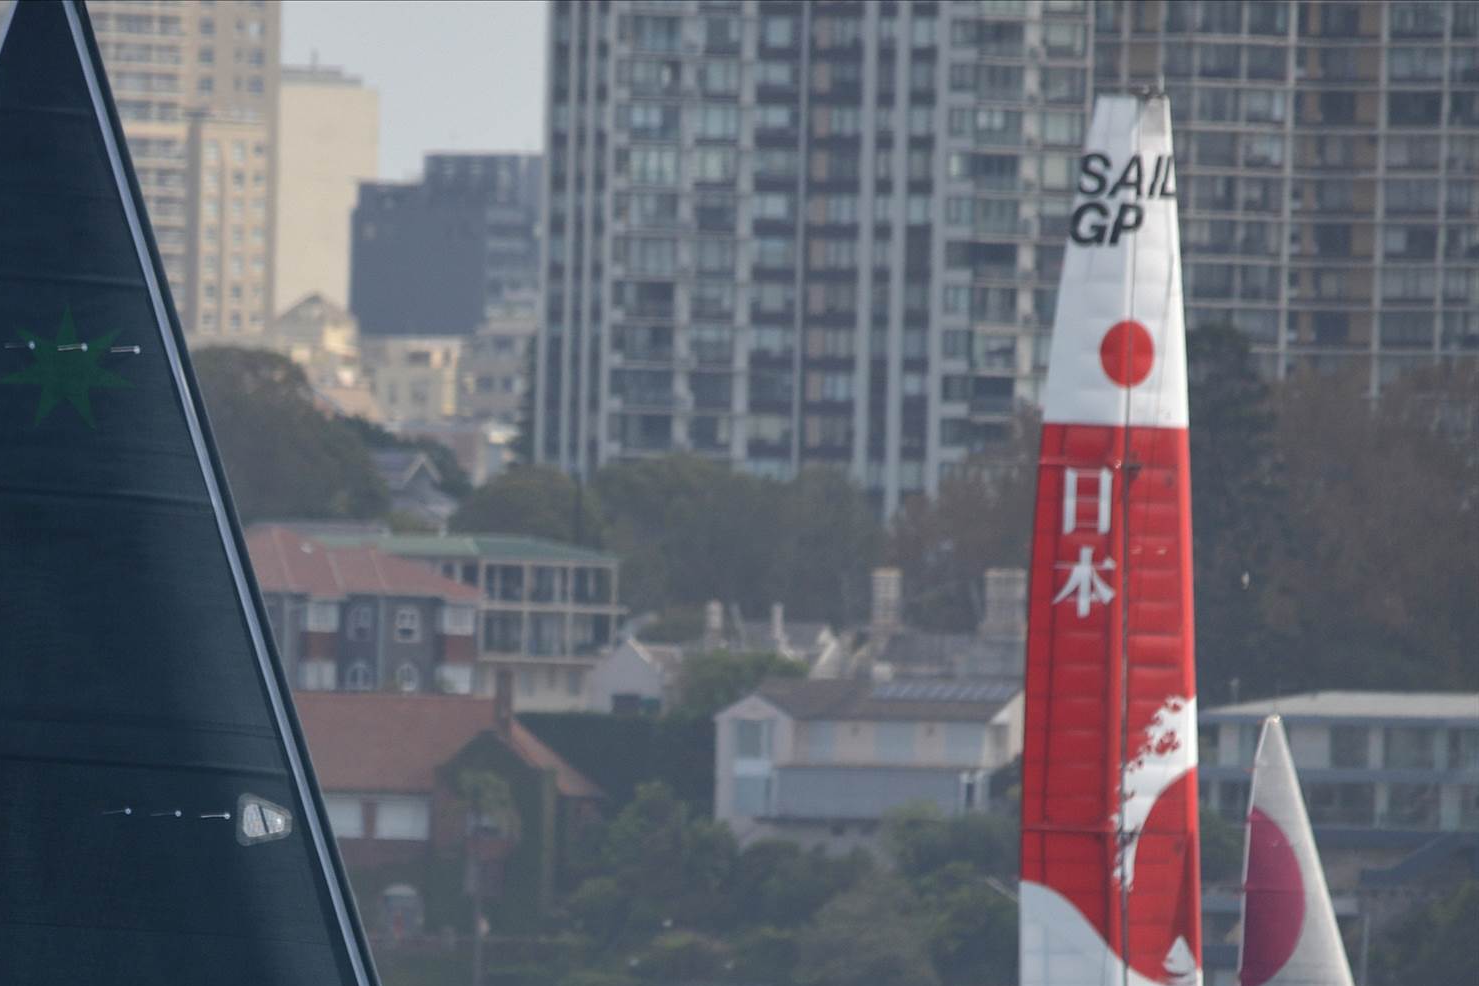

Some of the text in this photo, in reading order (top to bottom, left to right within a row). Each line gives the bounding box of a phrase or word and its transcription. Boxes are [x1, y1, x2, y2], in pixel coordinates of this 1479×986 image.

[1079, 153, 1176, 197] SAIL
[1070, 202, 1144, 246] GP
[1052, 466, 1116, 618] 日本
